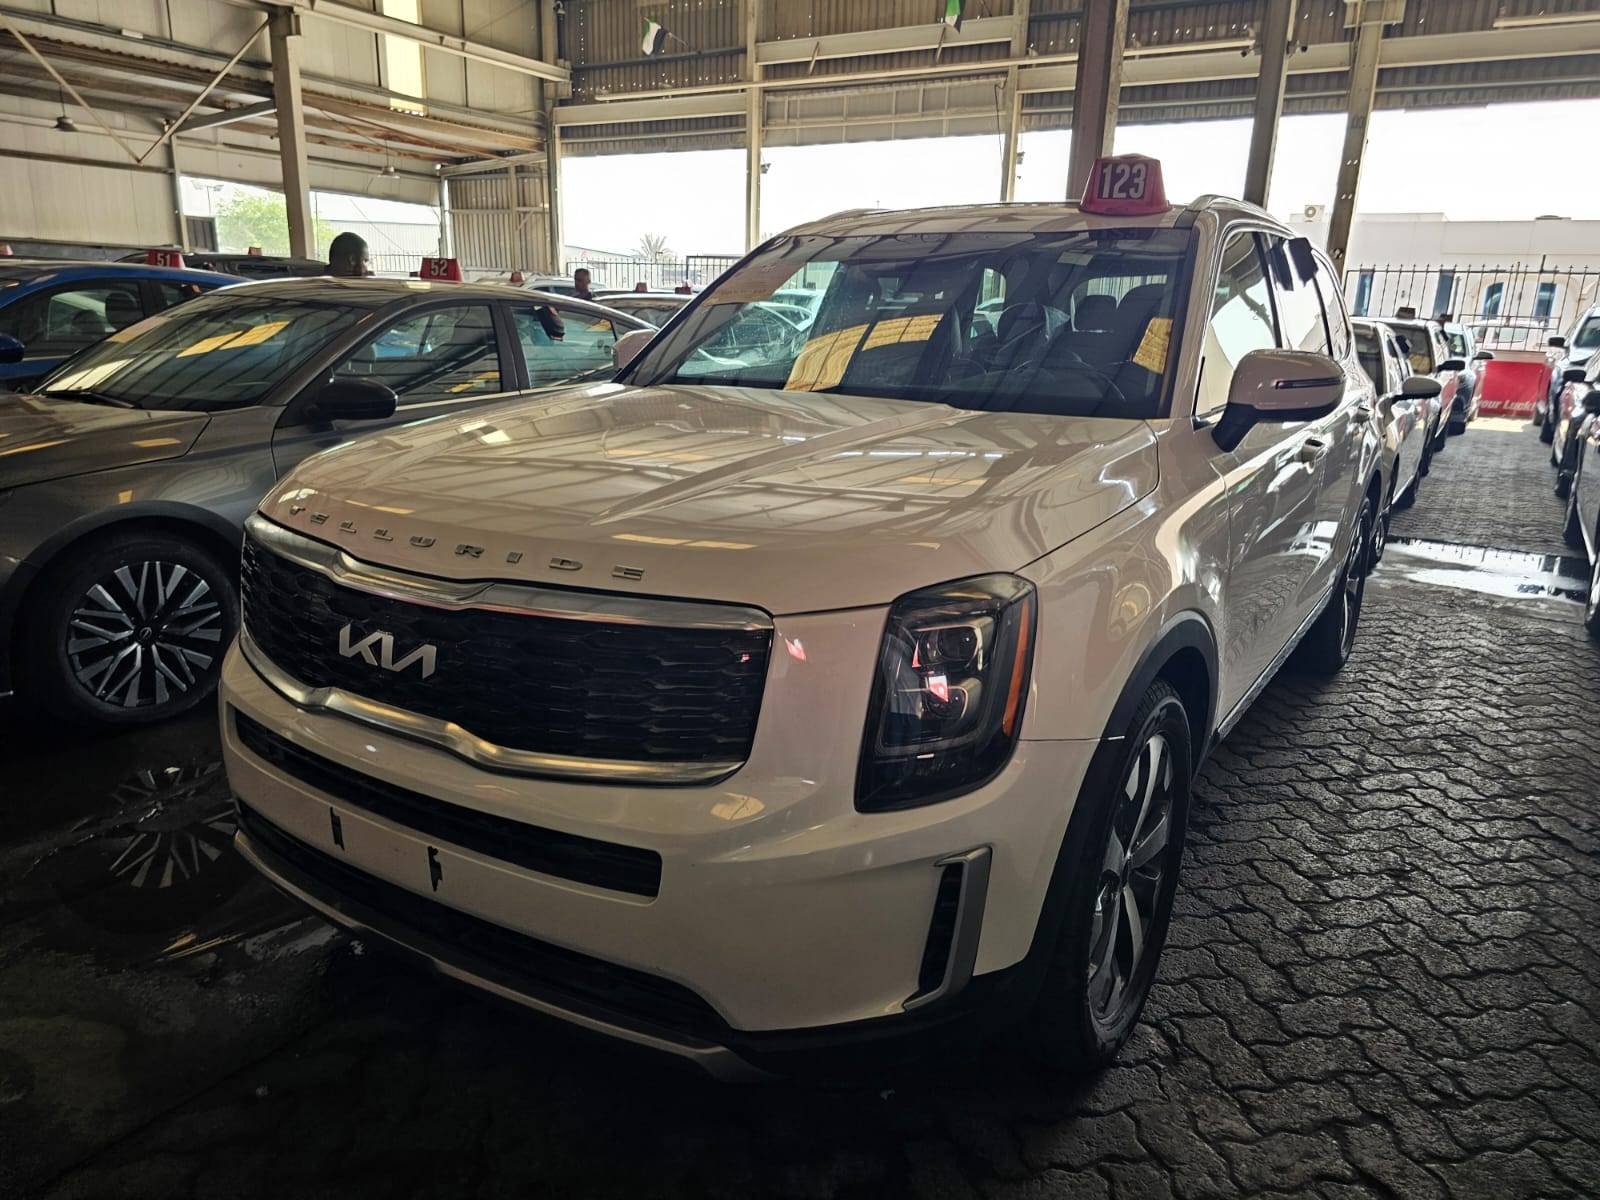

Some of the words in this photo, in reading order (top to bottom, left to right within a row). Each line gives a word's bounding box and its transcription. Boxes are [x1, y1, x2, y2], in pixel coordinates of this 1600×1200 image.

[1101, 163, 1146, 199] 123
[157, 253, 170, 267] 51
[430, 259, 448, 276] 52
[289, 505, 645, 580] TELLURIDE
[339, 623, 437, 678] KIA
